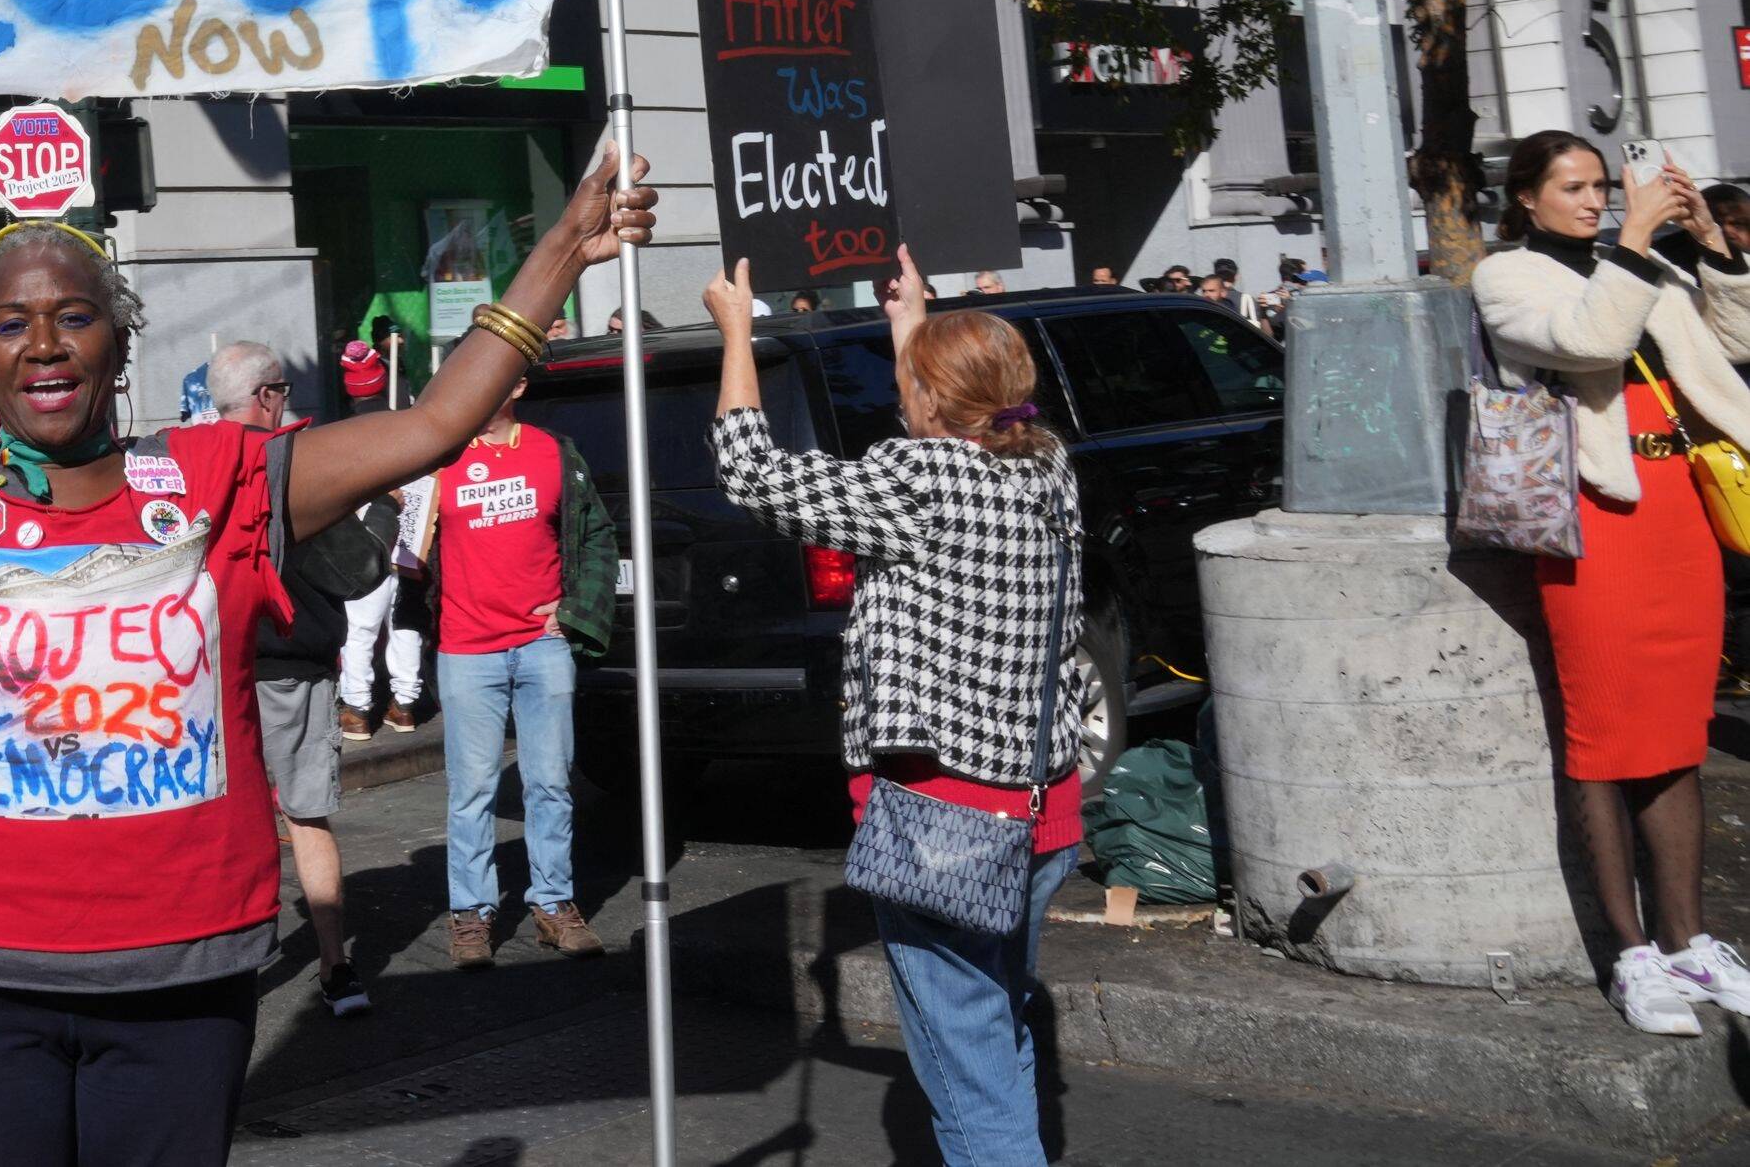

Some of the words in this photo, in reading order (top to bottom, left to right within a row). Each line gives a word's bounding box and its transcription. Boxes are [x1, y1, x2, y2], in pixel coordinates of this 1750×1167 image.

[777, 67, 868, 119] Was
[12, 117, 59, 136] VOTE
[731, 118, 888, 219] Elected
[7, 178, 49, 196] Project
[51, 171, 80, 187] 2025
[805, 220, 887, 259] too
[461, 483, 506, 502] TRUMP
[510, 480, 522, 493] IS
[486, 502, 496, 513] A
[499, 494, 533, 511] SCAB
[469, 516, 494, 529] VOTE
[497, 508, 539, 525] HARRIS
[22, 682, 183, 748] 2025
